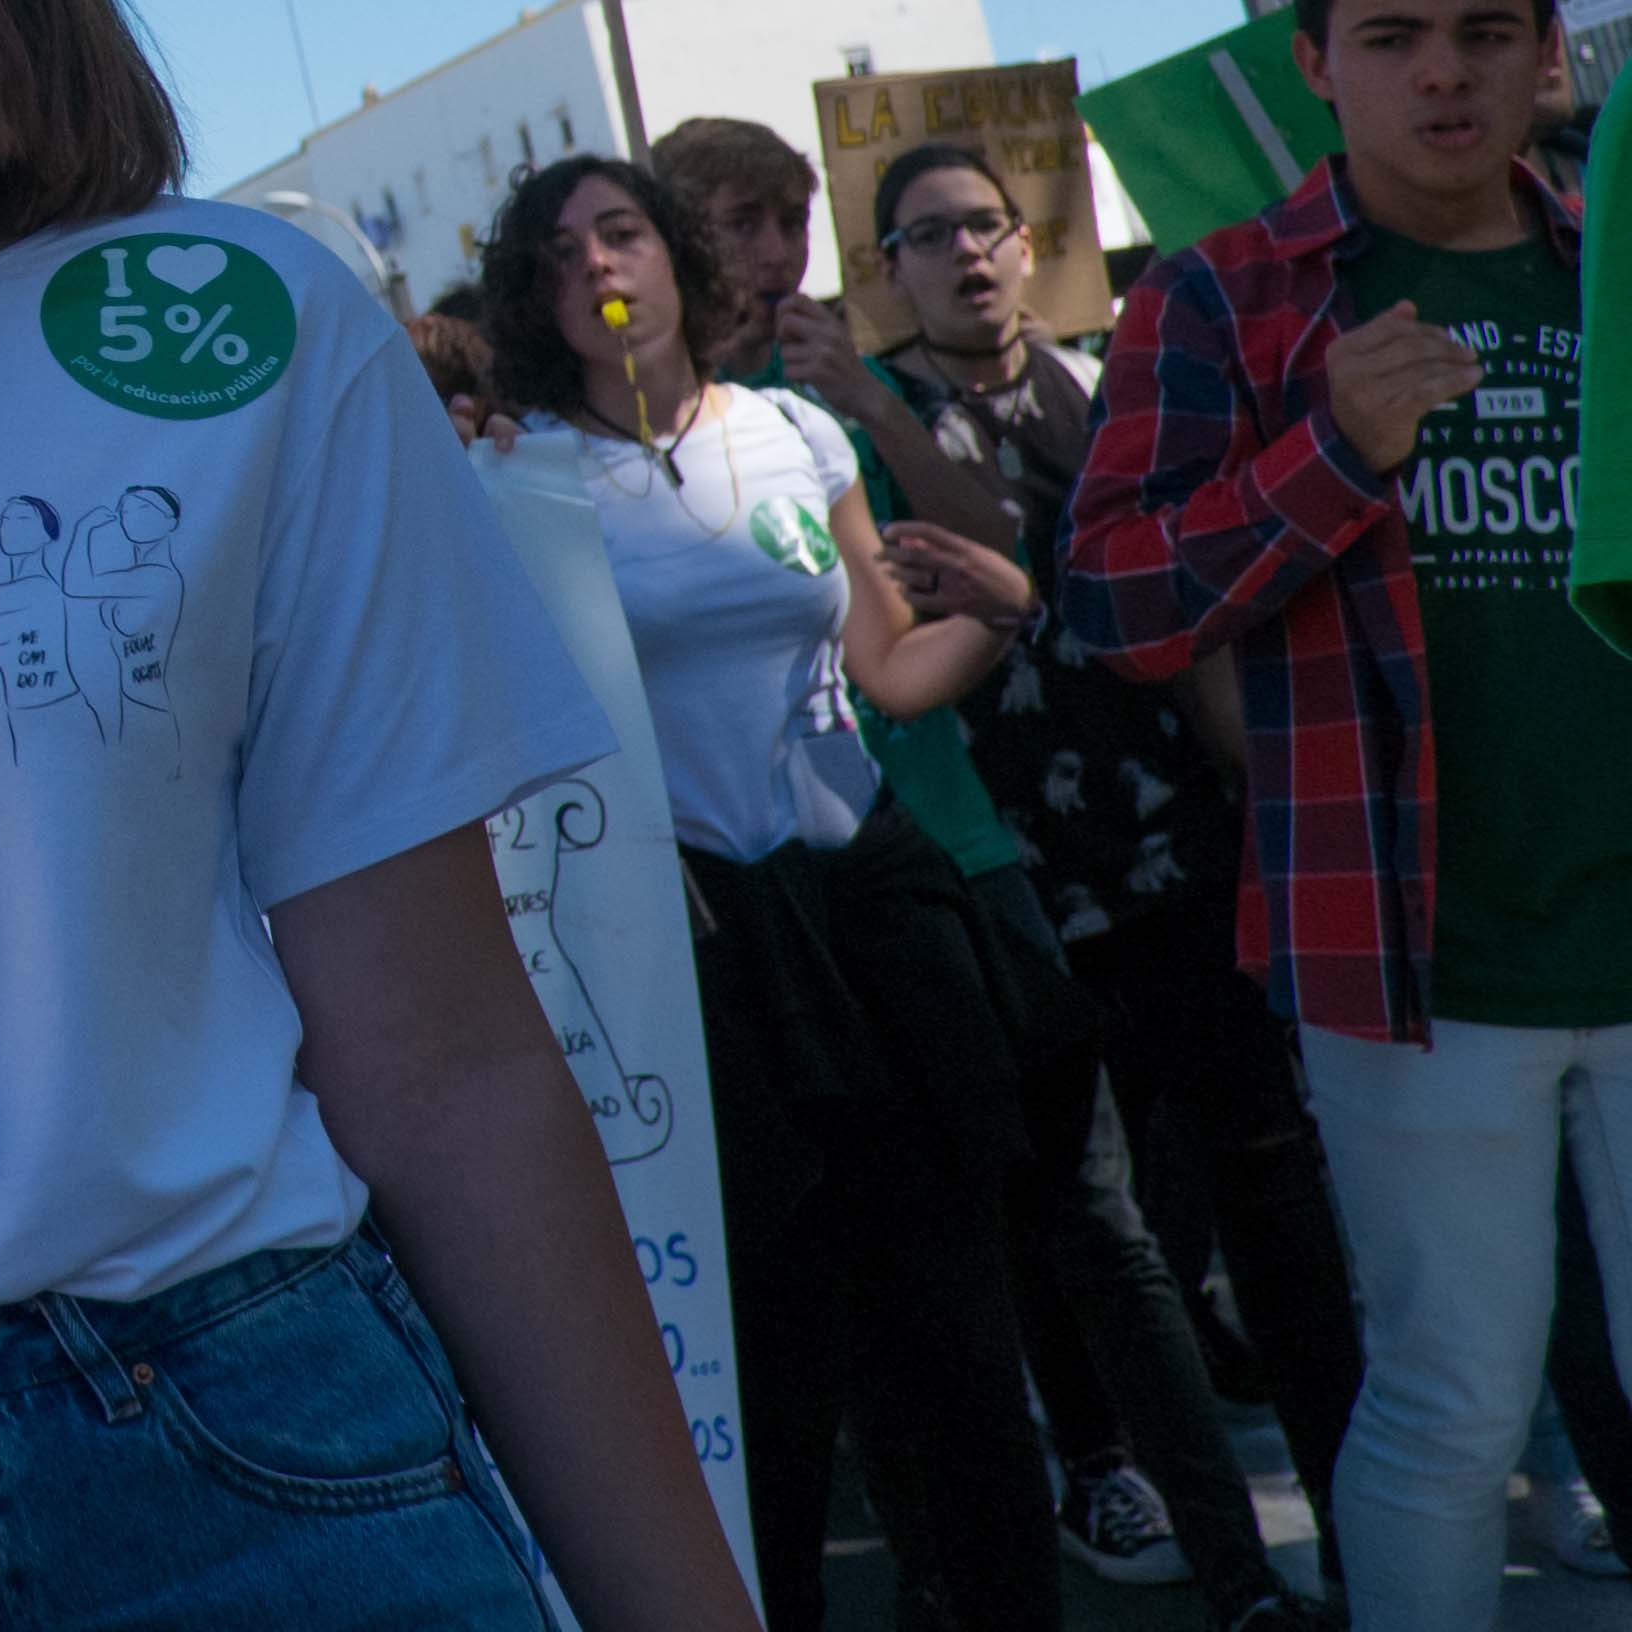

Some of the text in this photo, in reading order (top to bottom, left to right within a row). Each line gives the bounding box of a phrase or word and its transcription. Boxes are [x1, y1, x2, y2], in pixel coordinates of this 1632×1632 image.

[835, 86, 900, 148] LA
[100, 247, 133, 298] I
[98, 303, 250, 366] 5%
[70, 353, 280, 406] por la educación pública
[1420, 426, 1453, 444] RY
[16, 670, 58, 689] DO IT
[18, 649, 47, 666] CAN
